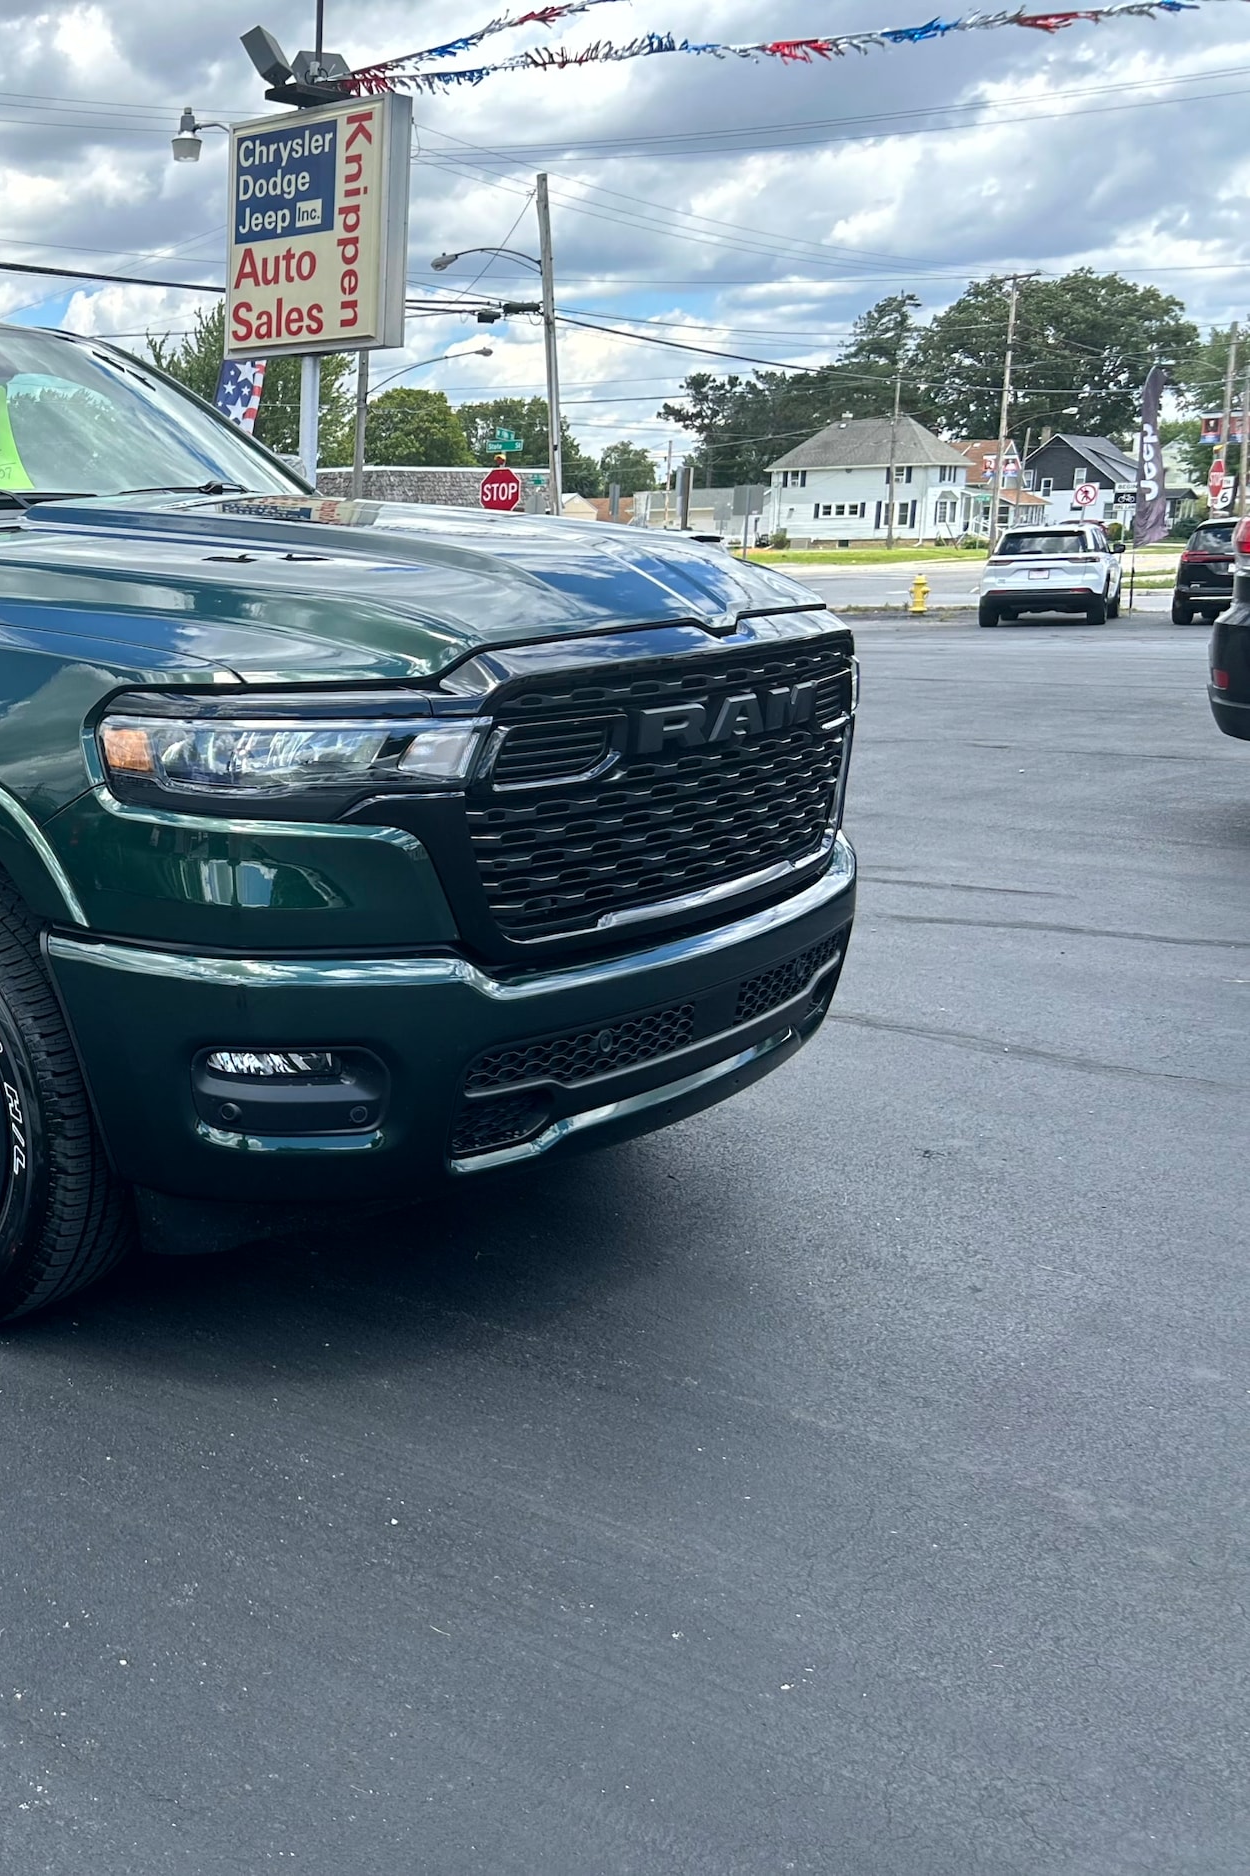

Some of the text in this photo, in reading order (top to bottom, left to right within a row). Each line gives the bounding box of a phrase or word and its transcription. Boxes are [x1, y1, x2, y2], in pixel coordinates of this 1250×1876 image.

[238, 130, 334, 167] Chrysler
[238, 169, 311, 200] Dodge
[238, 204, 321, 234] Jeep Inc.
[337, 111, 373, 328] Knippen
[234, 247, 317, 289] Auto
[231, 298, 324, 342] Sales
[483, 483, 517, 501] STOP
[639, 681, 817, 751] RAM
